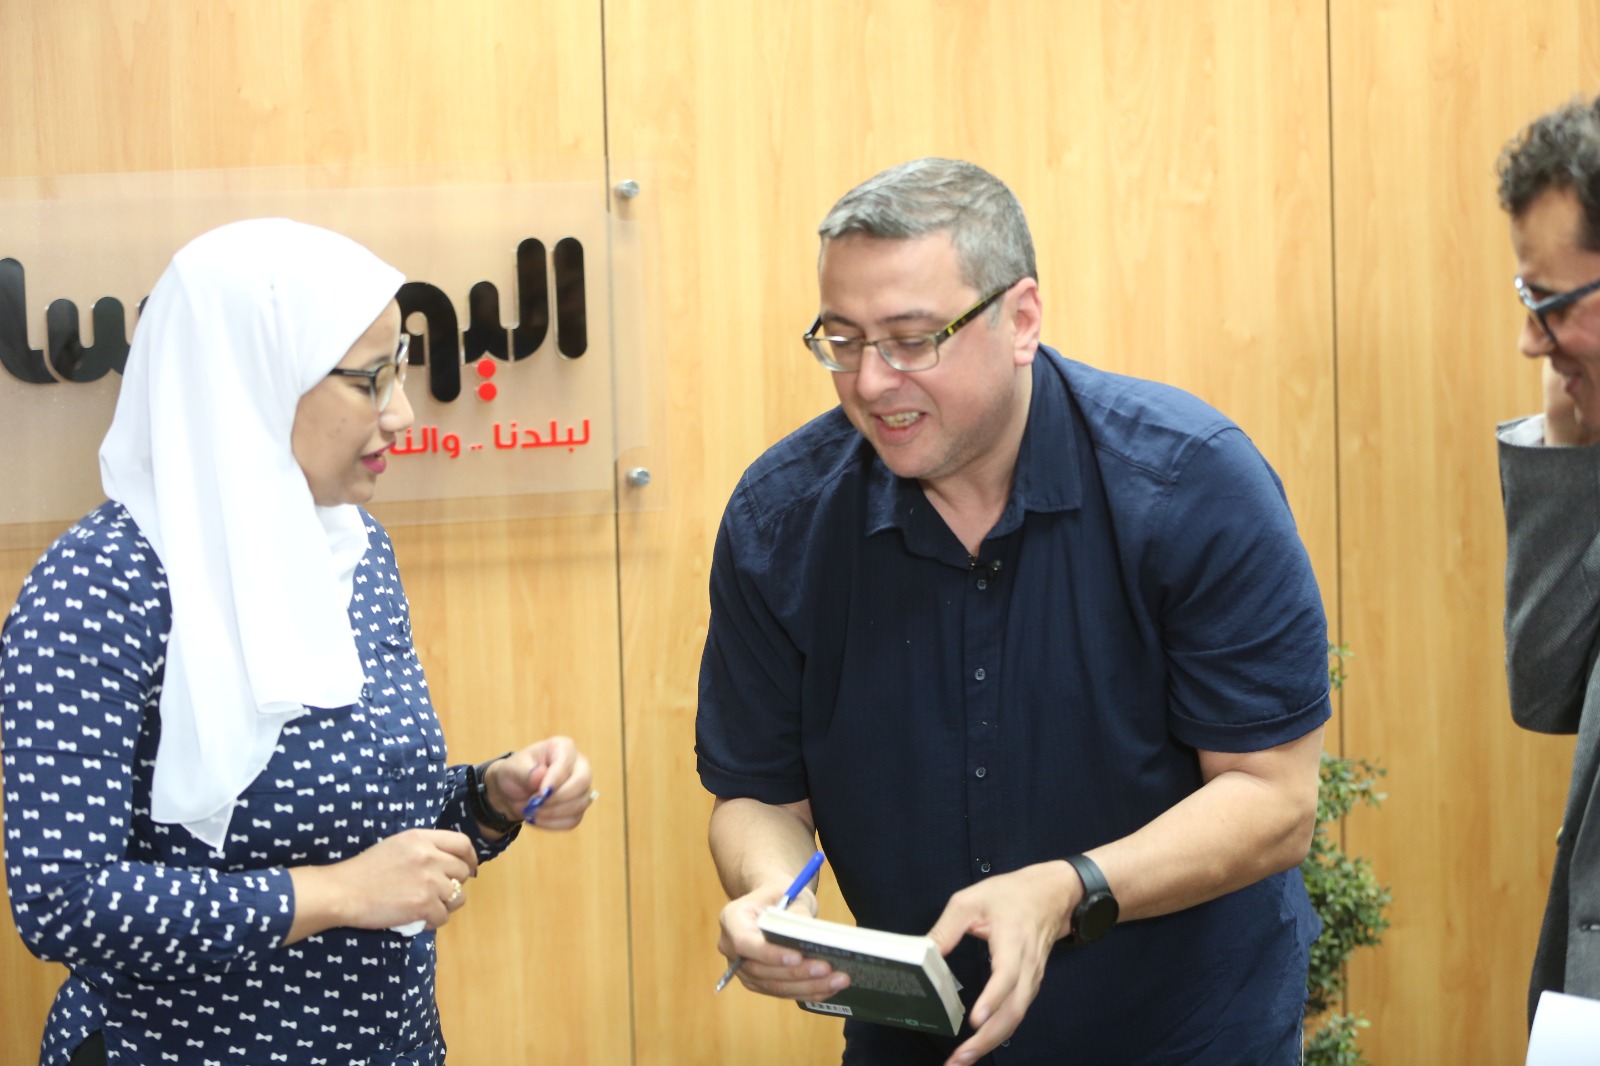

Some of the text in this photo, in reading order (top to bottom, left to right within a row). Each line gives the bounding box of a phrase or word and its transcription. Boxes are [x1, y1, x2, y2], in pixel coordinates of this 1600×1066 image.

[395, 237, 588, 402] اليو
[389, 425, 461, 459] والن
[493, 418, 591, 453] لبلدنا
